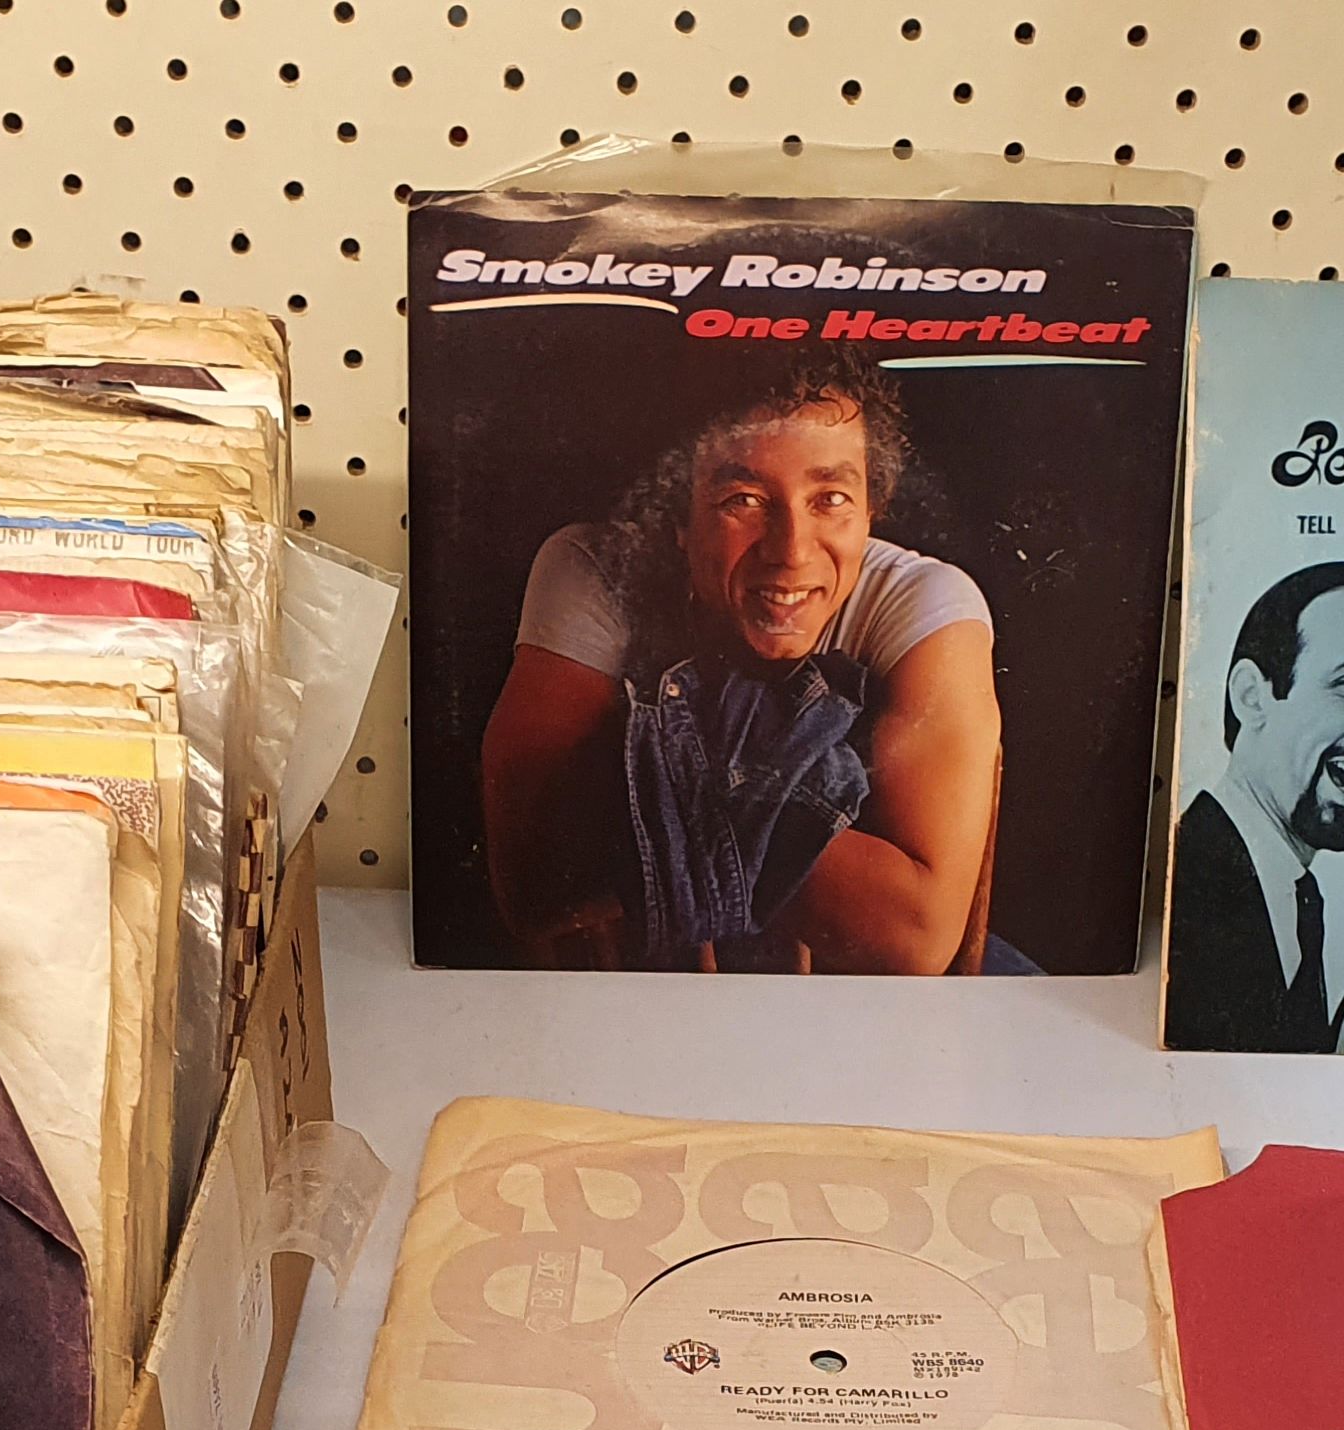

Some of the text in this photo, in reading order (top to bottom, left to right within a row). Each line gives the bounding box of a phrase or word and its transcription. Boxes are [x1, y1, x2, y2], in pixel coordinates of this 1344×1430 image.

[436, 250, 1047, 297] Smokey Robinson
[684, 309, 1152, 345] One Heartbeat
[1297, 515, 1337, 537] TELL
[778, 1291, 873, 1303] AMBROSIA
[720, 1385, 949, 1399] READY FOR CAMARILLO
